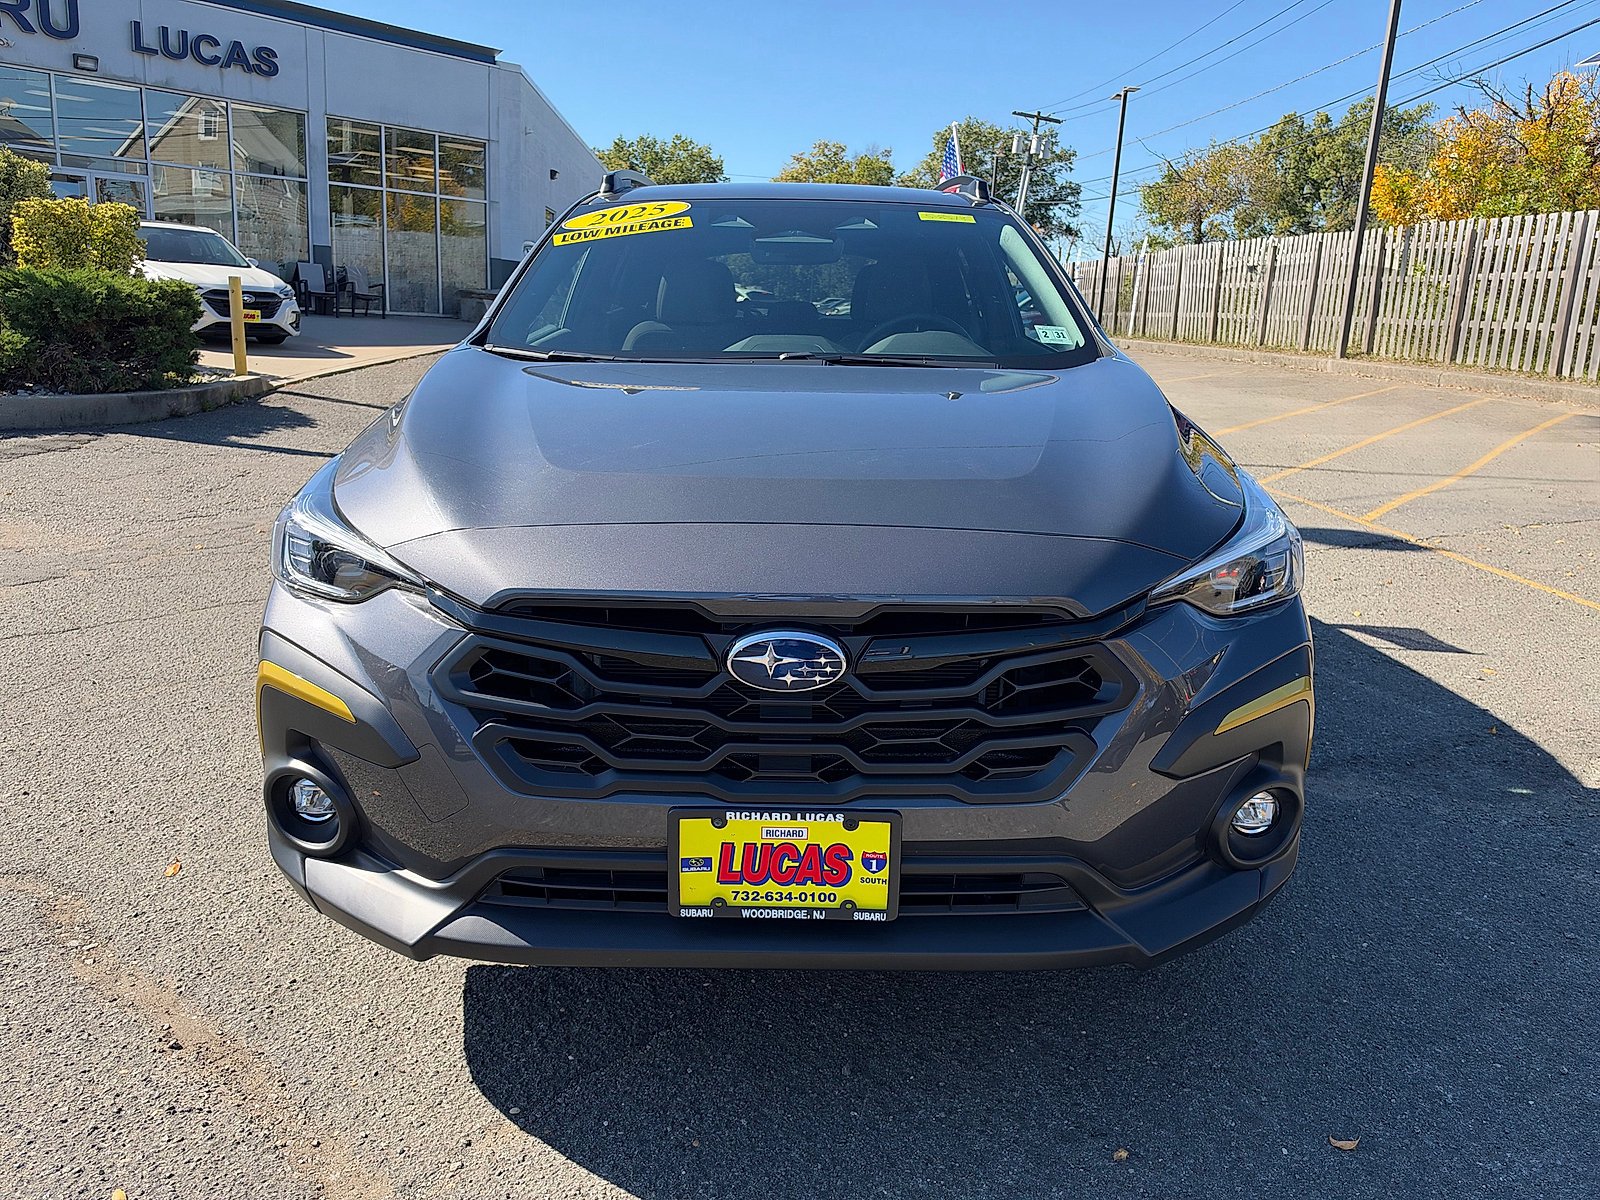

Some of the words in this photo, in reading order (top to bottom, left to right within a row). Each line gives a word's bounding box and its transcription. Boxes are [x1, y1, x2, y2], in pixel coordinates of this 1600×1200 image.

[130, 20, 280, 77] LUCAS
[587, 203, 668, 227] 2025
[560, 230, 604, 243] LOW
[604, 218, 684, 236] MILEAGE
[1041, 330, 1050, 338] 2
[1054, 331, 1067, 339] 31
[726, 811, 791, 821] RICHARD
[796, 813, 845, 822] LUCAS
[765, 829, 804, 838] RICHARD
[716, 841, 854, 887] LUCAS
[869, 859, 878, 872] 1
[860, 877, 887, 885] SOUTH
[731, 890, 837, 903] 732-634-0100
[680, 908, 714, 918] SUBARU
[741, 909, 811, 919] WOODBRIDGE,
[813, 910, 826, 920] NJ
[853, 911, 887, 922] SUBARU
